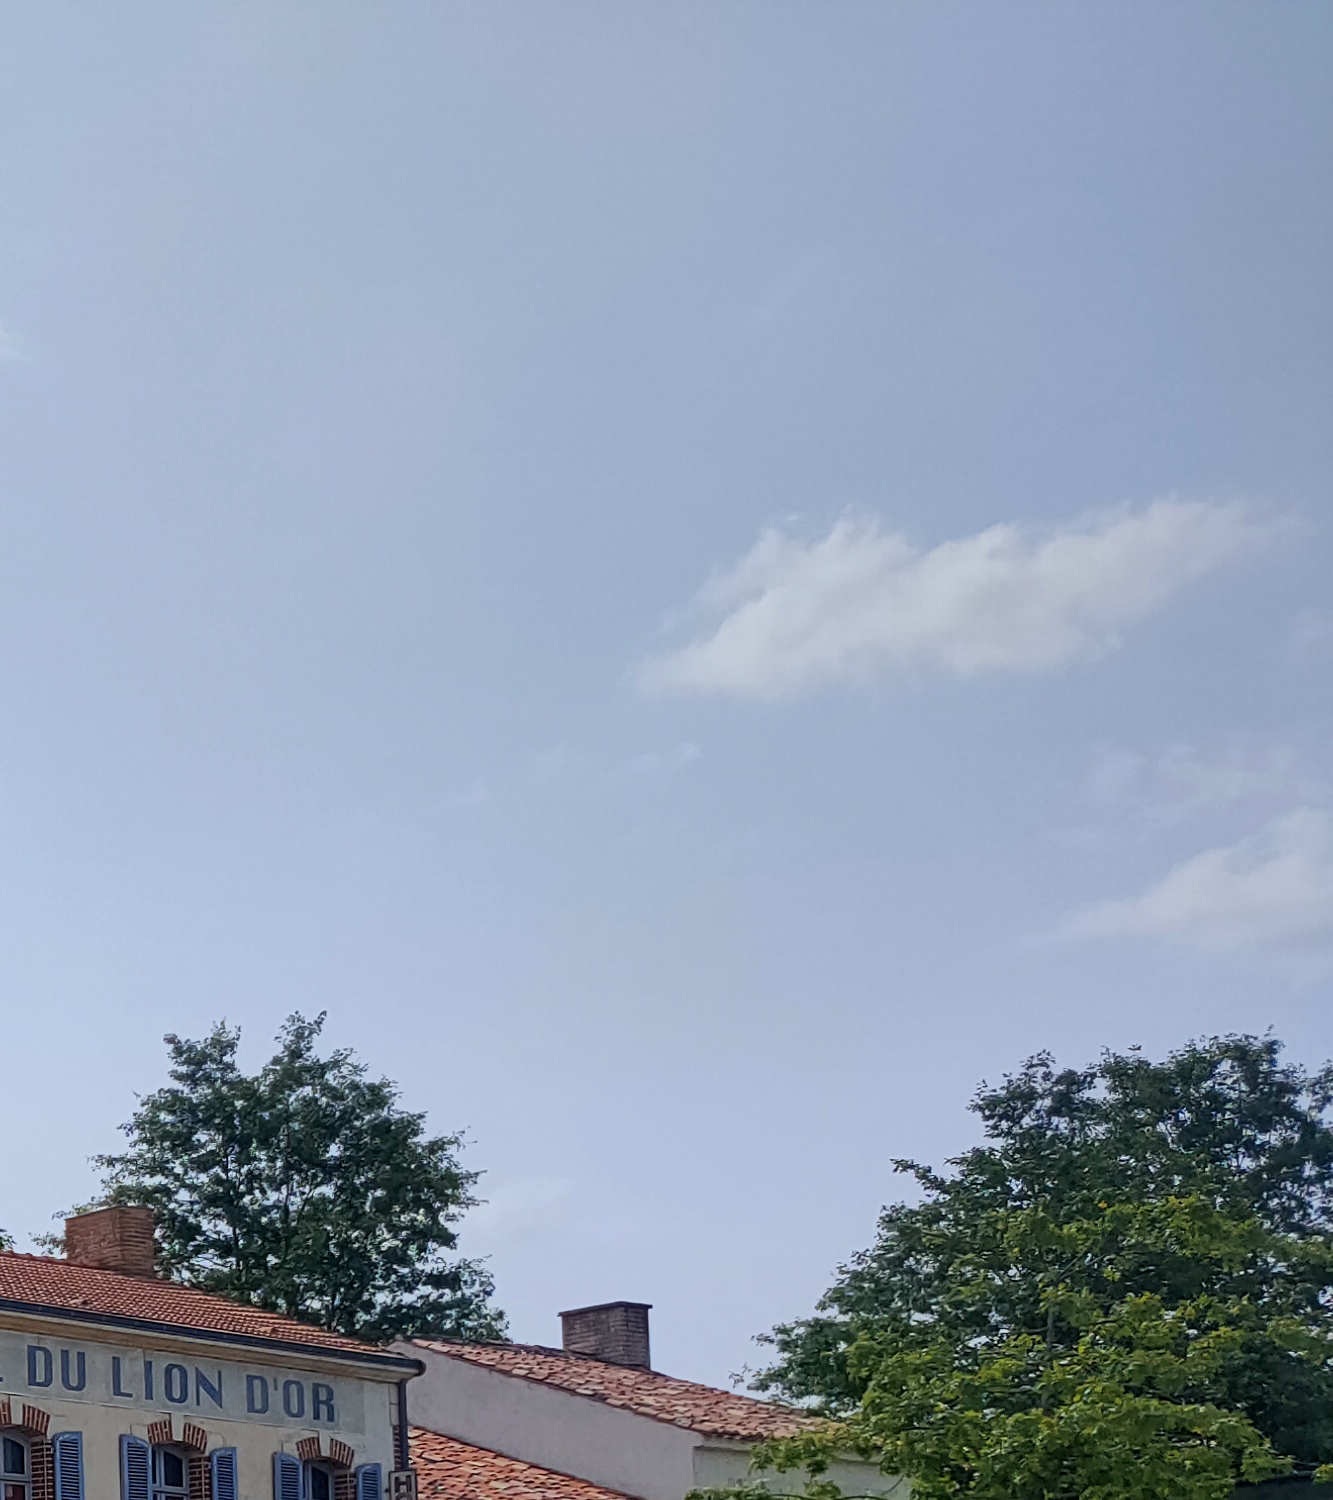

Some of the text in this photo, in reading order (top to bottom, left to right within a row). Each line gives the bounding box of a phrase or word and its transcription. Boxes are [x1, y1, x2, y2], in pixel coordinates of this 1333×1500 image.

[27, 1345, 86, 1392] DU
[111, 1356, 223, 1409] LION
[245, 1374, 335, 1422] D'OR
